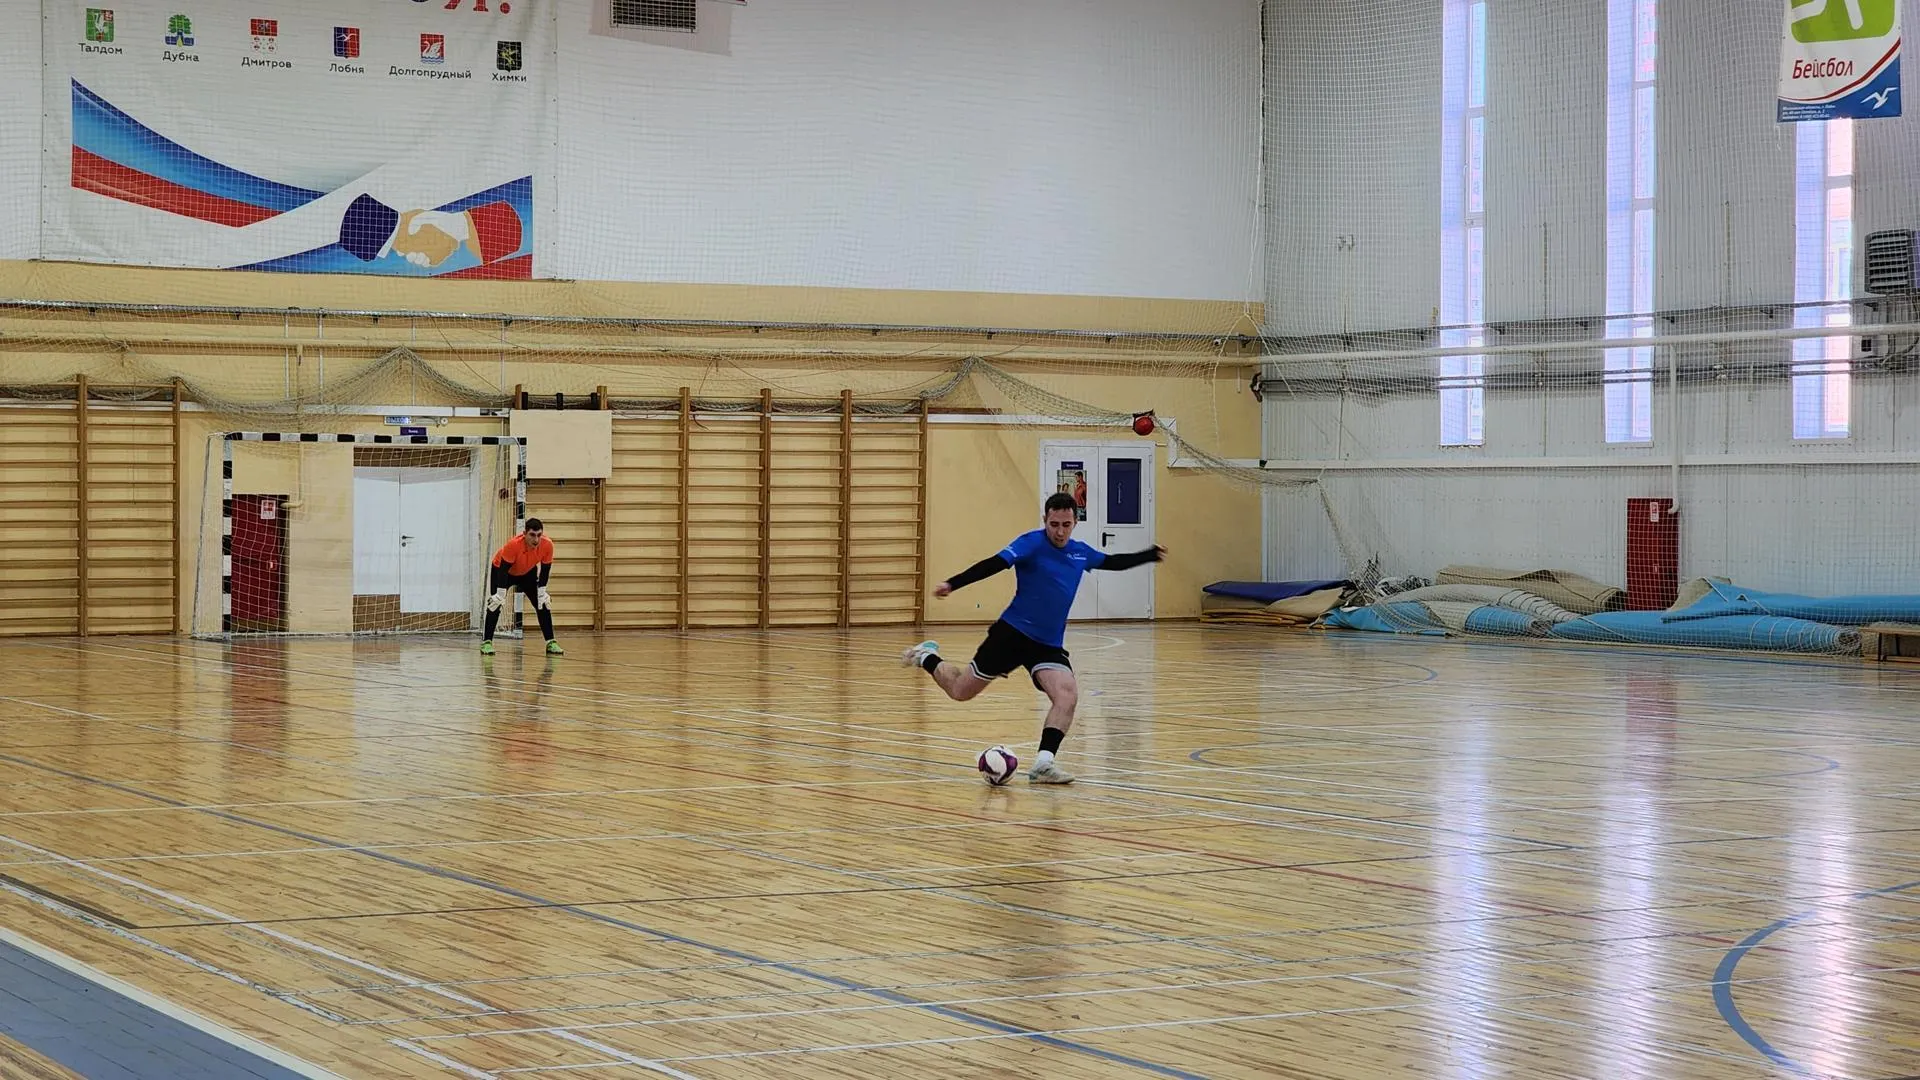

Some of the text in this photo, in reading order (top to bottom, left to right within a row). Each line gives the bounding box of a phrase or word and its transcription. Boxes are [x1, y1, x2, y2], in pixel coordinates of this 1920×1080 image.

[78, 42, 123, 55] Талдом
[162, 51, 200, 63] Дубна
[241, 56, 292, 69] Дмитров
[329, 63, 365, 75] Лобня
[388, 66, 472, 80] Долгопрудный
[1792, 57, 1854, 80] Бейсбол
[491, 72, 528, 83] Химки
